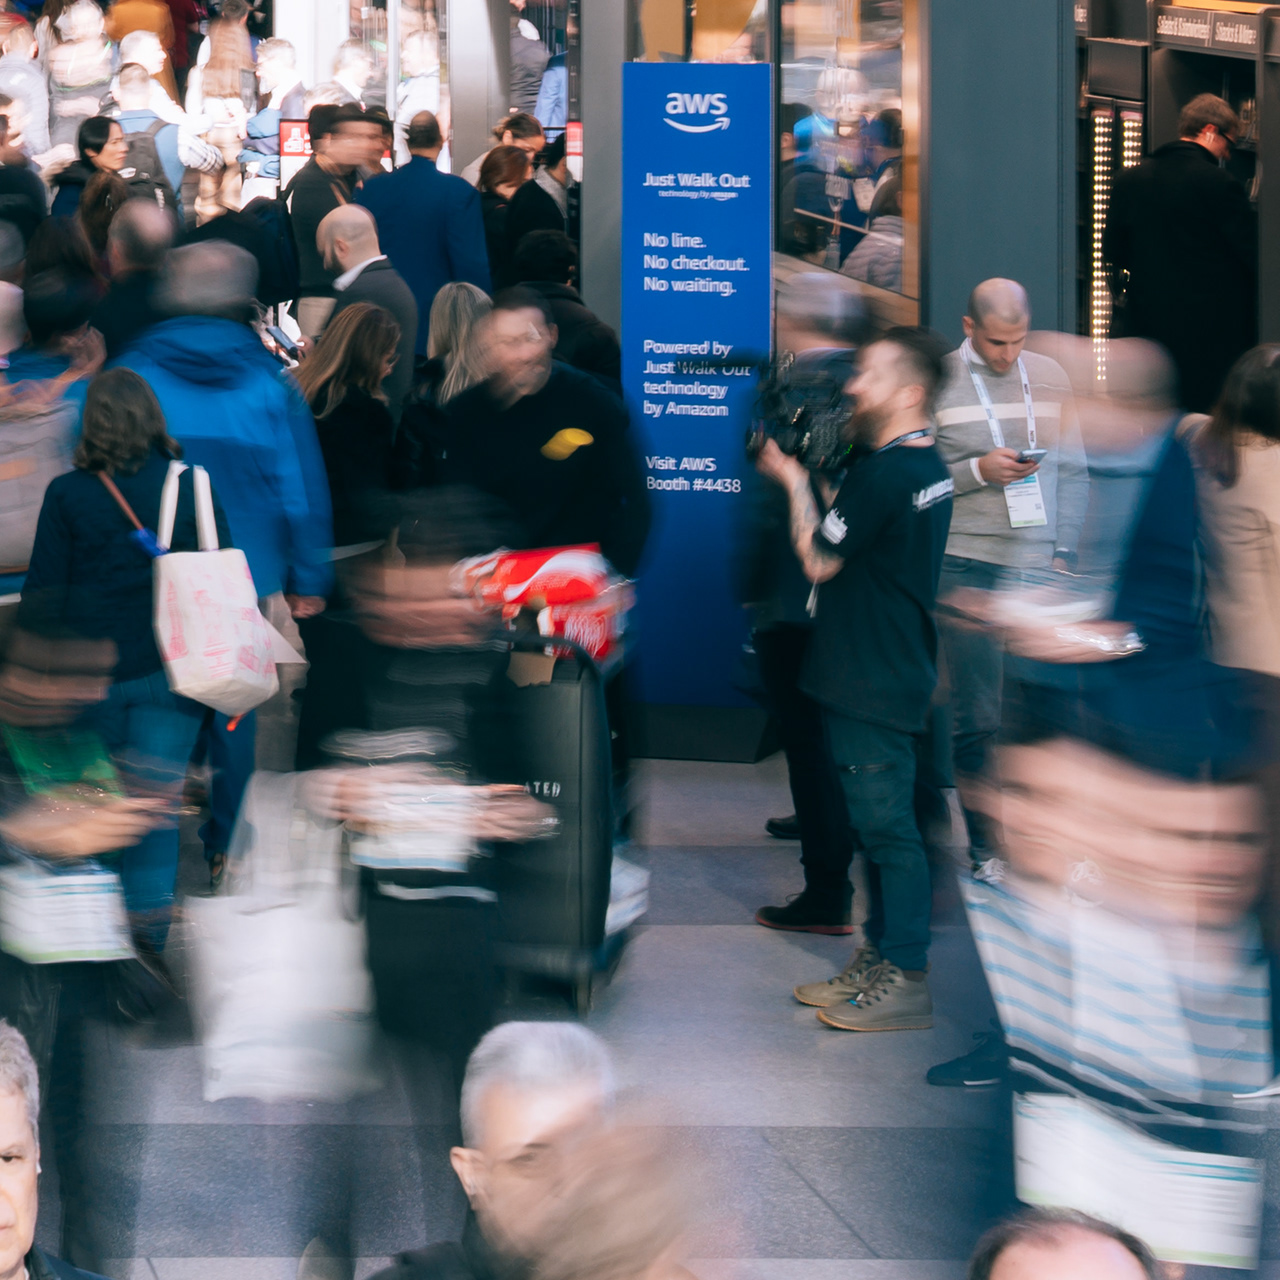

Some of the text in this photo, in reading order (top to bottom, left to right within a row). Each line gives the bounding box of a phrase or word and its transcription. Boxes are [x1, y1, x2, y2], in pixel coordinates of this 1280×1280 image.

[665, 92, 728, 115] aws
[643, 172, 751, 188] Just Walk Out
[643, 232, 707, 249] No line.
[643, 254, 750, 271] No checkout.
[643, 276, 737, 297] No waiting.
[643, 339, 734, 359] Powered by
[643, 359, 677, 375] Just
[643, 380, 729, 400] technology
[643, 399, 730, 418] by Amazon
[645, 455, 717, 472] Visit AWS
[646, 475, 691, 492] Booth
